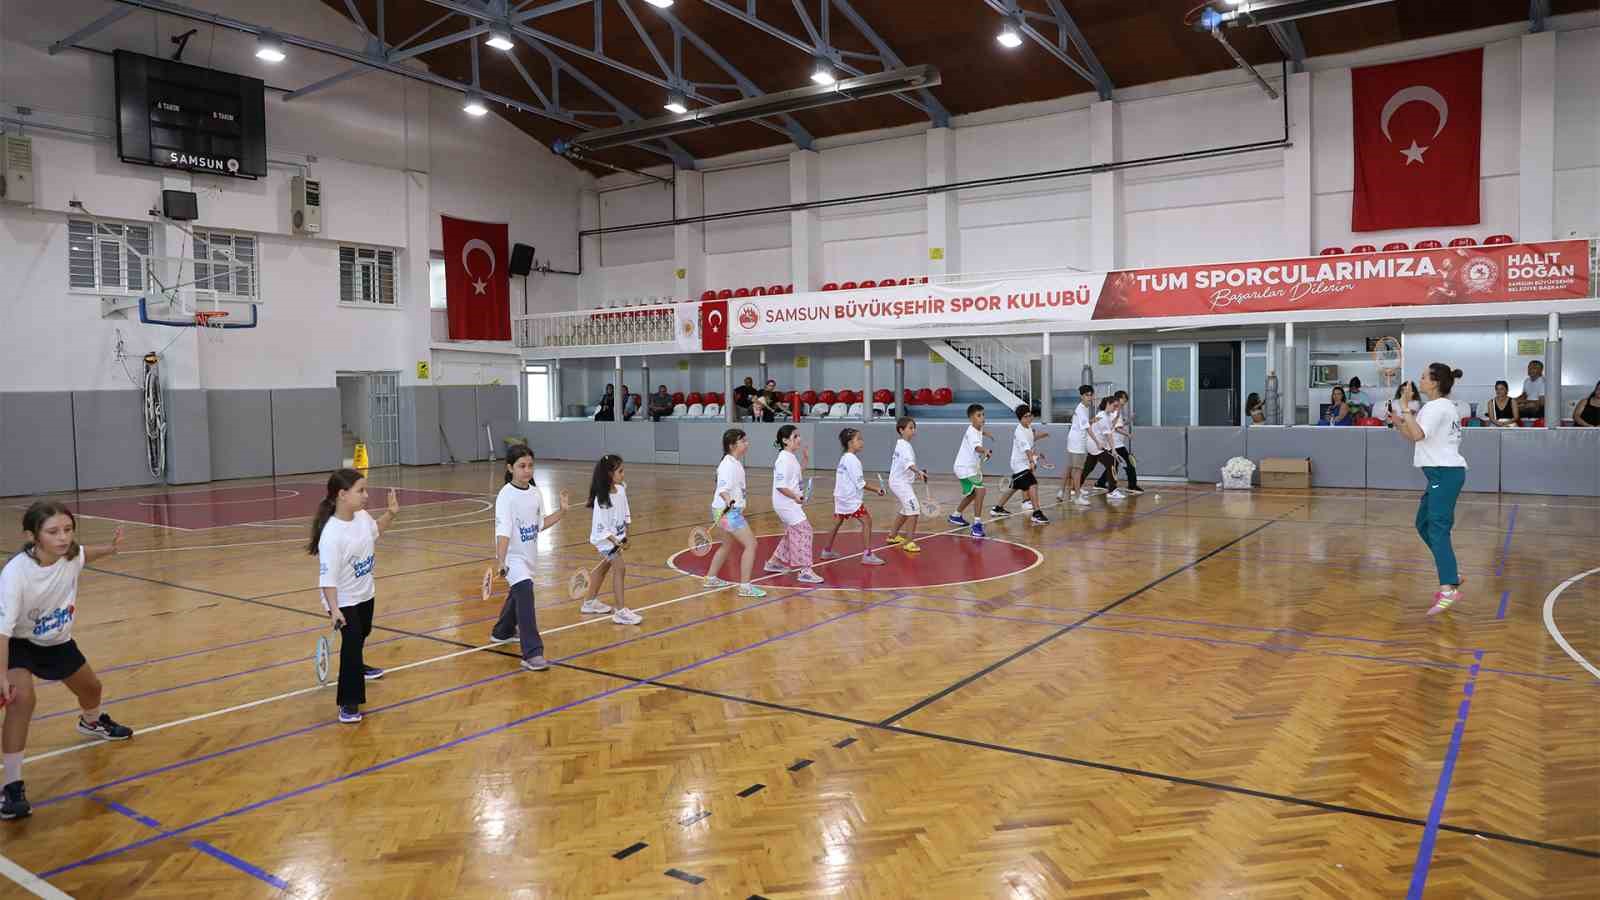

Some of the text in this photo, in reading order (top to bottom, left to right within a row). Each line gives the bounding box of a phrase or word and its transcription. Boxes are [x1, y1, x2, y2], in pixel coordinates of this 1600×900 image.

[170, 152, 224, 169] SAMSUN
[1194, 256, 1437, 288] SPORCULARIMIZA
[1508, 265, 1575, 279] DOĞAN
[766, 285, 1091, 323] SAMSUN BÜYÜKŞEHİR SPOR KULUBÜ
